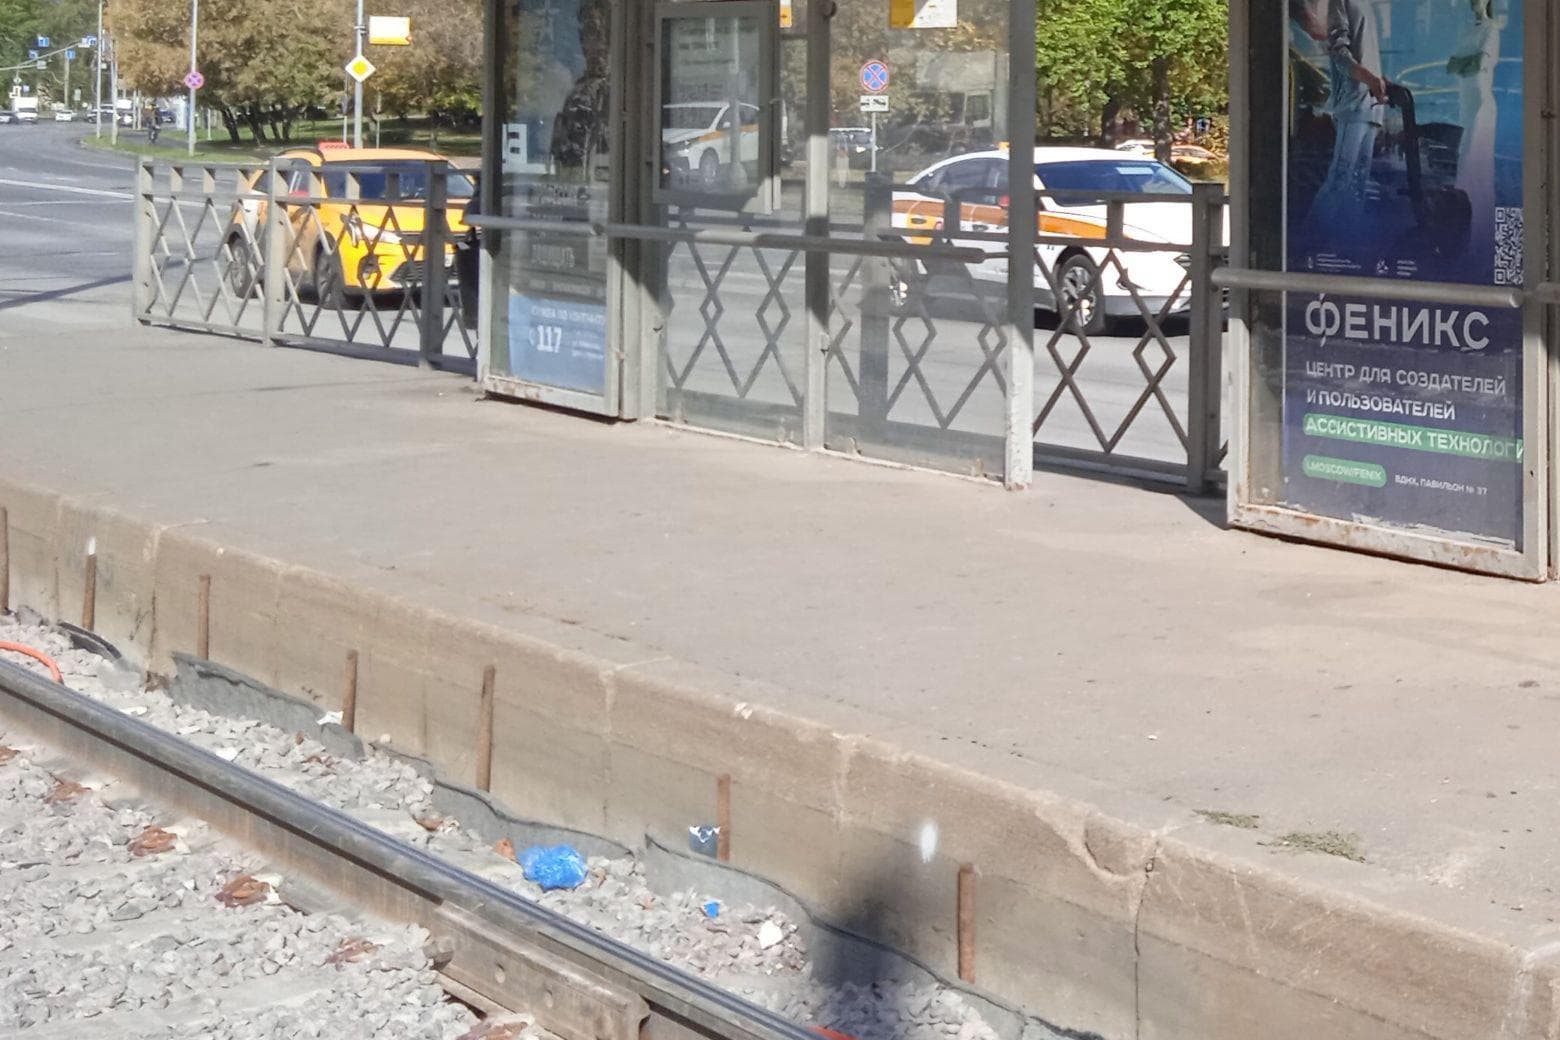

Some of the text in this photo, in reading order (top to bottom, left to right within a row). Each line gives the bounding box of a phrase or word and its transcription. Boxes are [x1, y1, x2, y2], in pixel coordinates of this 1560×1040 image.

[1305, 293, 1490, 350] ФЕНИКС
[536, 324, 562, 353] 117
[1305, 360, 1506, 395] ЦЕНТР ДЛЯ СОЗДАТЕЛЕЙ
[1307, 388, 1456, 420] И ПОЛЬЗОВАТЕЛЕЙ
[1305, 417, 1423, 446] АССИСТИВНЫХ
